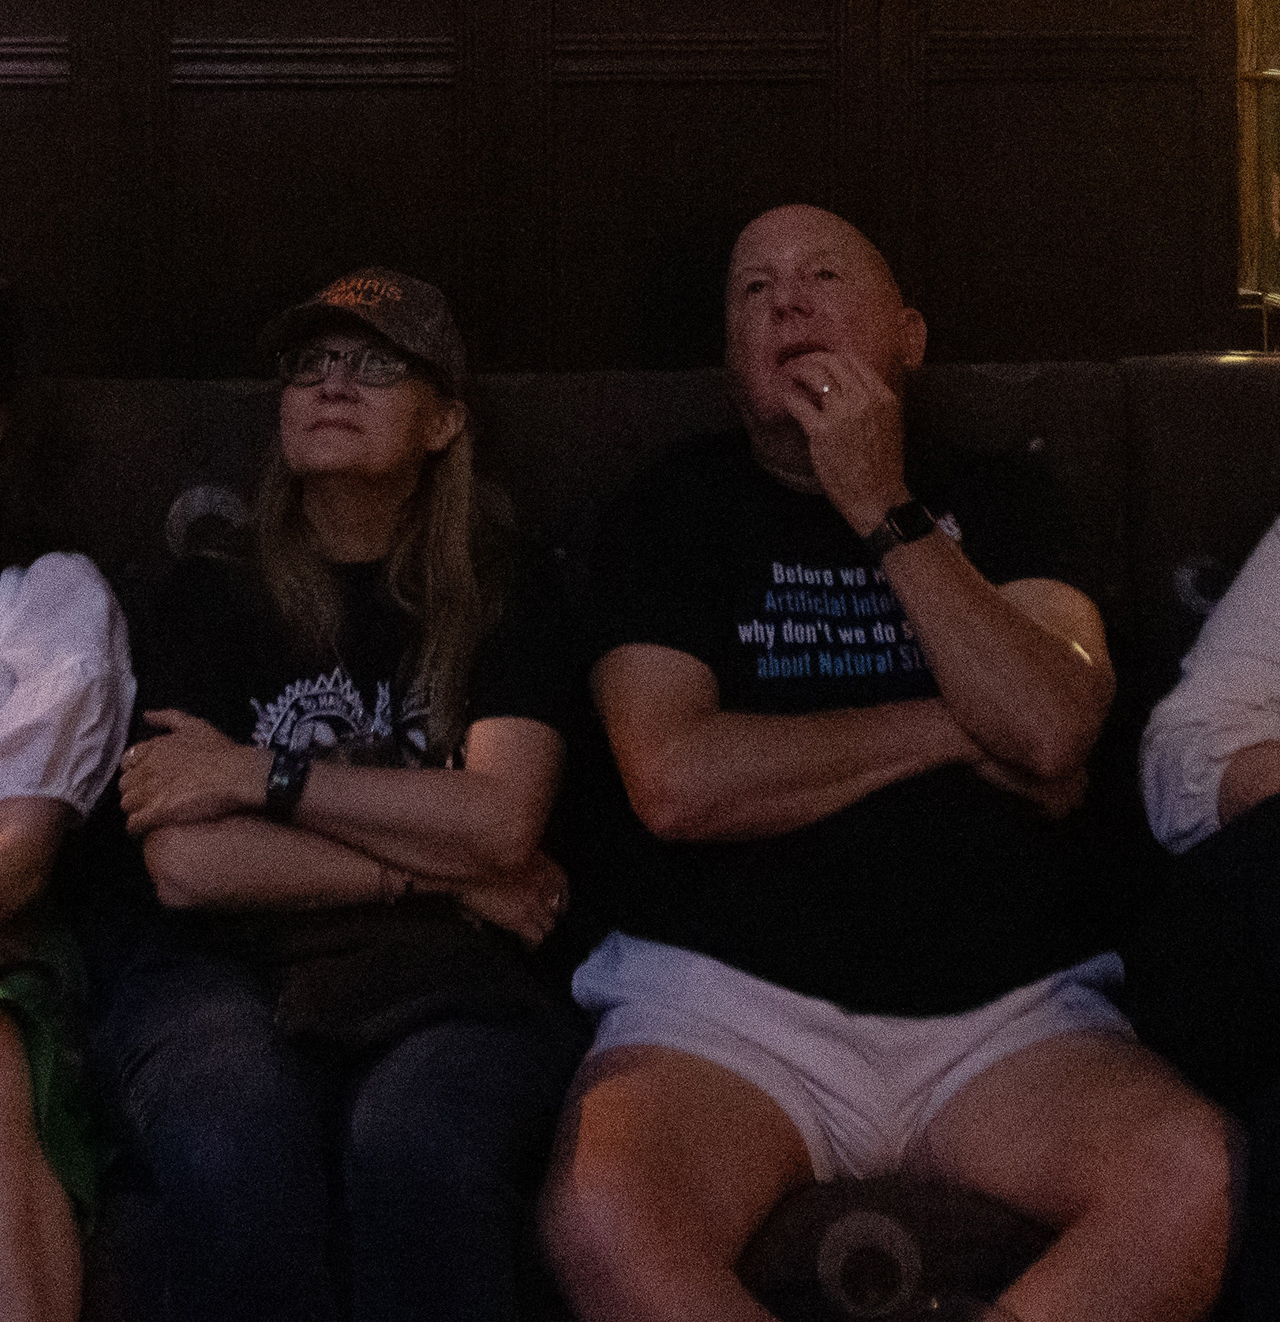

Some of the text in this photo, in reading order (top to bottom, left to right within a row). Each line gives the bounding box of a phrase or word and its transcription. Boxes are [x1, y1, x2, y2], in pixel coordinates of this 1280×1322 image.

[771, 561, 834, 587] Before
[838, 567, 868, 587] we
[764, 590, 847, 618] Artificial
[736, 620, 776, 650] why
[782, 618, 834, 645] don't
[837, 626, 867, 645] we
[873, 620, 896, 644] do
[757, 649, 813, 680] about
[818, 648, 894, 679] Natural
